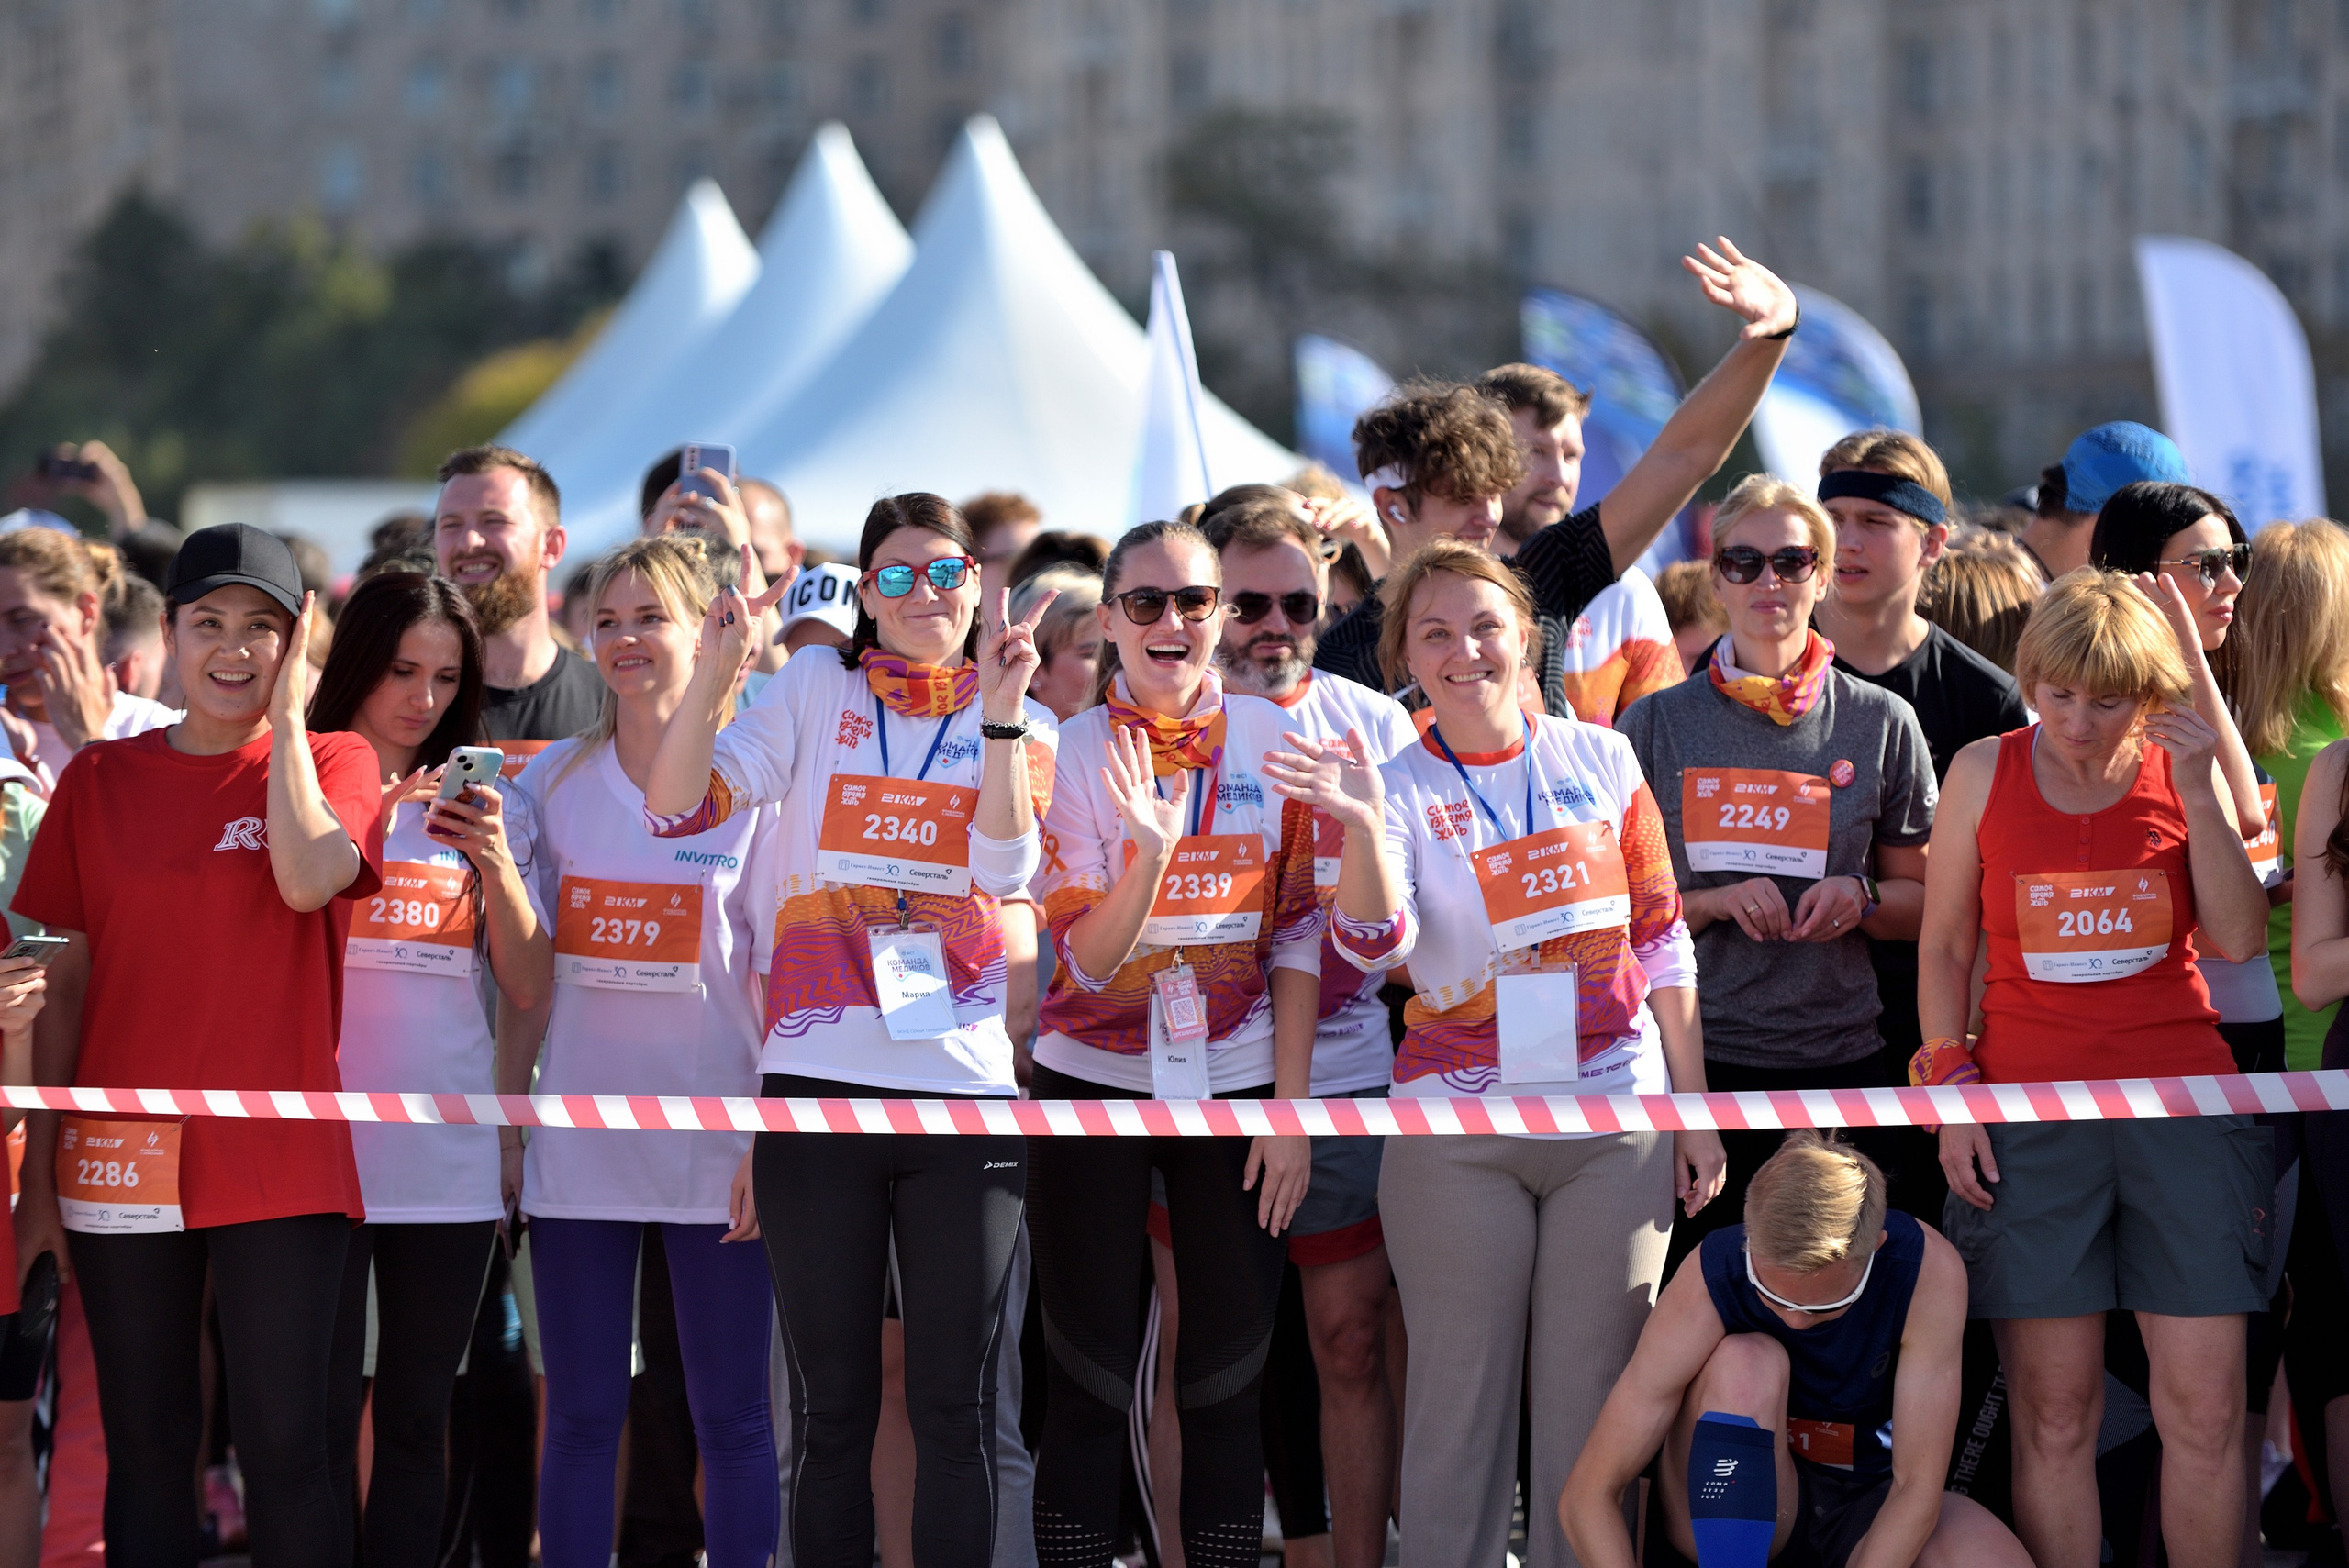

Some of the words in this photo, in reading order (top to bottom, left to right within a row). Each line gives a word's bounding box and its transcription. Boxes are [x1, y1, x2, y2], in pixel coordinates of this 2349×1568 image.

[841, 709, 874, 729] самое
[834, 730, 859, 749] жить
[842, 784, 867, 793] самое
[841, 790, 867, 800] время
[841, 796, 861, 806] жить
[1426, 799, 1469, 817] самое
[1430, 809, 1474, 829] время
[1719, 803, 1791, 831] 2249
[863, 813, 939, 847] 2340
[1434, 824, 1468, 841] жить
[674, 850, 738, 869] INVITRO
[1486, 851, 1510, 863] самое
[1765, 851, 1805, 863] Северсталь
[909, 868, 950, 881] Северсталь
[1521, 861, 1591, 899] 2321
[1166, 873, 1233, 901] 2339
[2029, 884, 2054, 894] самое
[2030, 897, 2050, 907] жить
[369, 897, 440, 928] 2380
[1581, 907, 1615, 917] Северсталь
[1215, 921, 1246, 930] Северсталь
[2057, 907, 2134, 938] 2064
[590, 917, 662, 947] 2379
[416, 951, 452, 962] Северсталь
[886, 957, 930, 967] КОМАНДА
[2111, 956, 2150, 966] Северсталь
[635, 968, 676, 979] Северсталь
[892, 963, 931, 973] МЕДИКОВ
[901, 991, 931, 1000] Мария
[1167, 1055, 1188, 1064] Юлия
[77, 1158, 139, 1188] 2286
[118, 1211, 160, 1221] Северсталь
[1954, 1437, 1987, 1483] THERE
[1972, 1392, 2004, 1439] OUGHT
